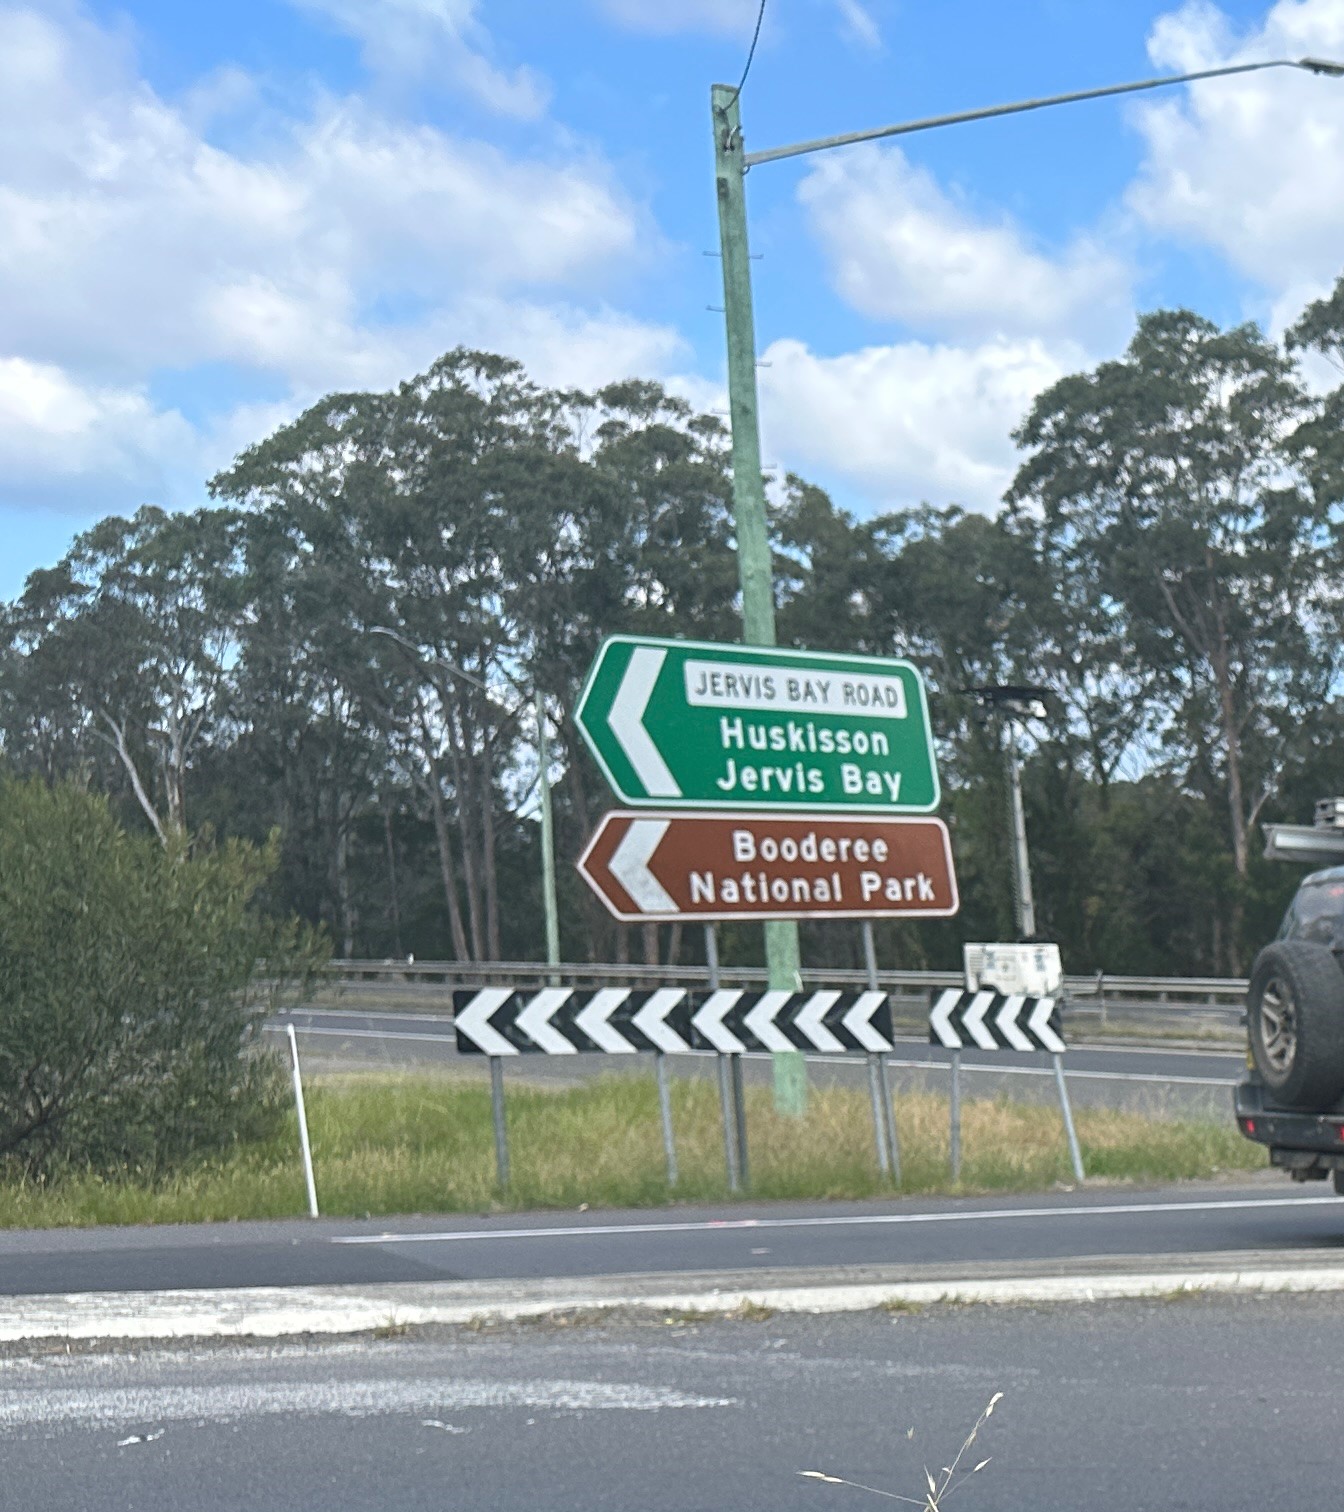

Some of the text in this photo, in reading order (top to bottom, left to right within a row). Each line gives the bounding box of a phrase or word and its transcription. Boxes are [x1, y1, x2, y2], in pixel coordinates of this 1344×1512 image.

[694, 671, 899, 708] JERVIS BAY ROAD
[719, 716, 890, 756] Huskisson
[716, 758, 901, 802] Jervis Bay
[732, 829, 889, 862] Booderee
[689, 870, 936, 904] National Park
